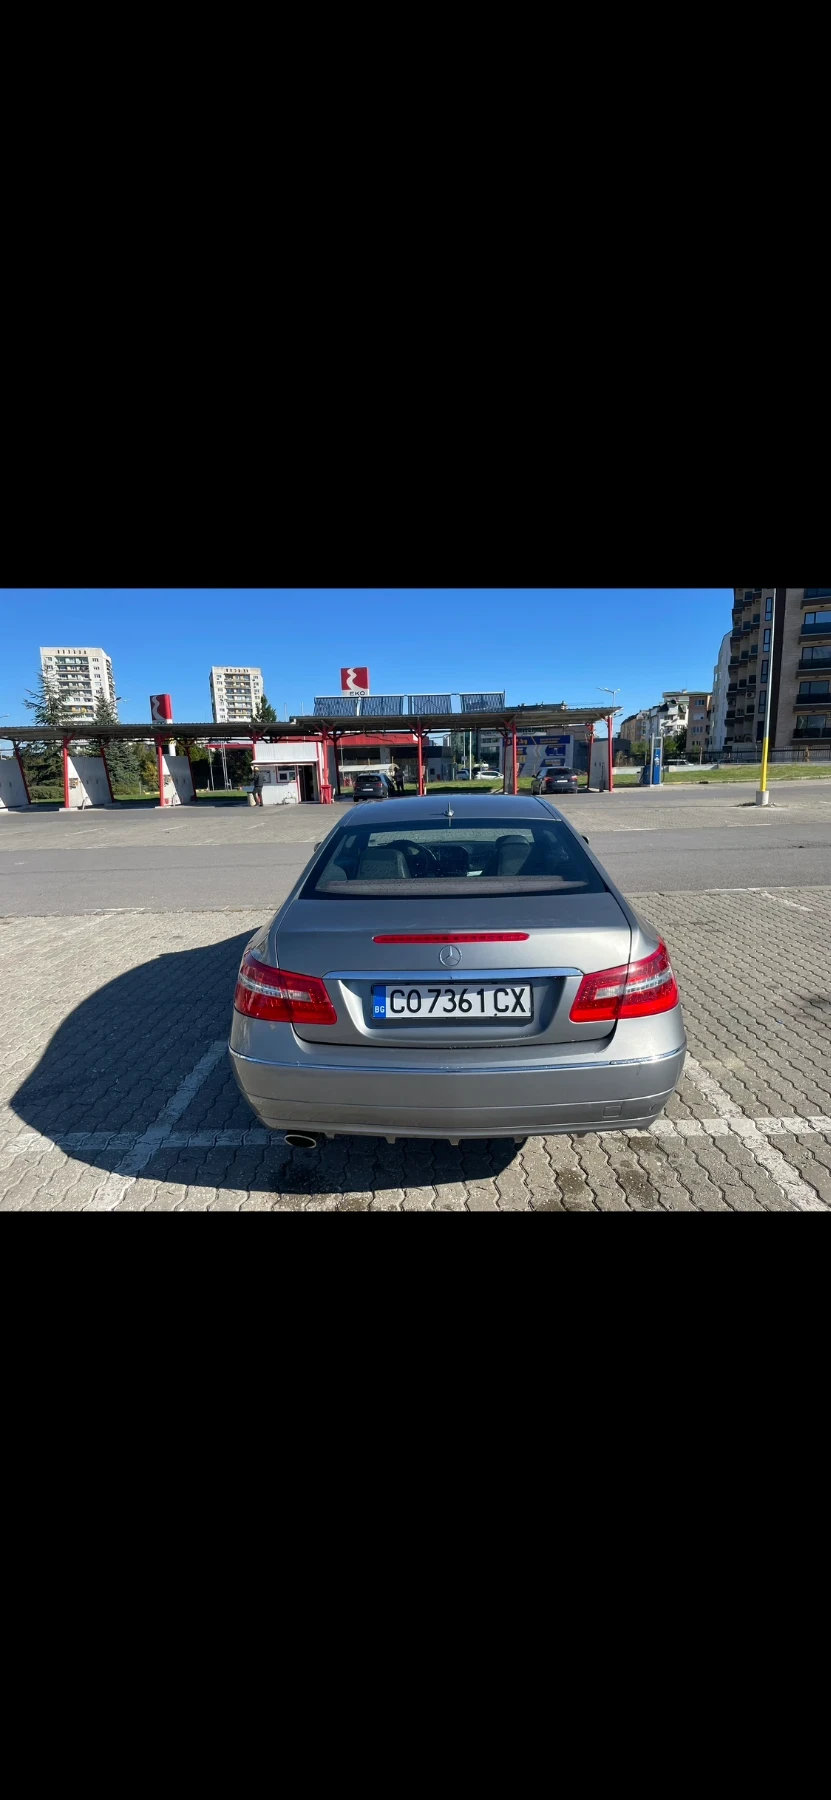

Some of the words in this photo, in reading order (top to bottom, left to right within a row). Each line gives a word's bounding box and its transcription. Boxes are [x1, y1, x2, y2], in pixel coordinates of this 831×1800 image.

[374, 1005, 385, 1014] BG
[428, 988, 486, 1014] 7361
[494, 988, 527, 1013] CX
